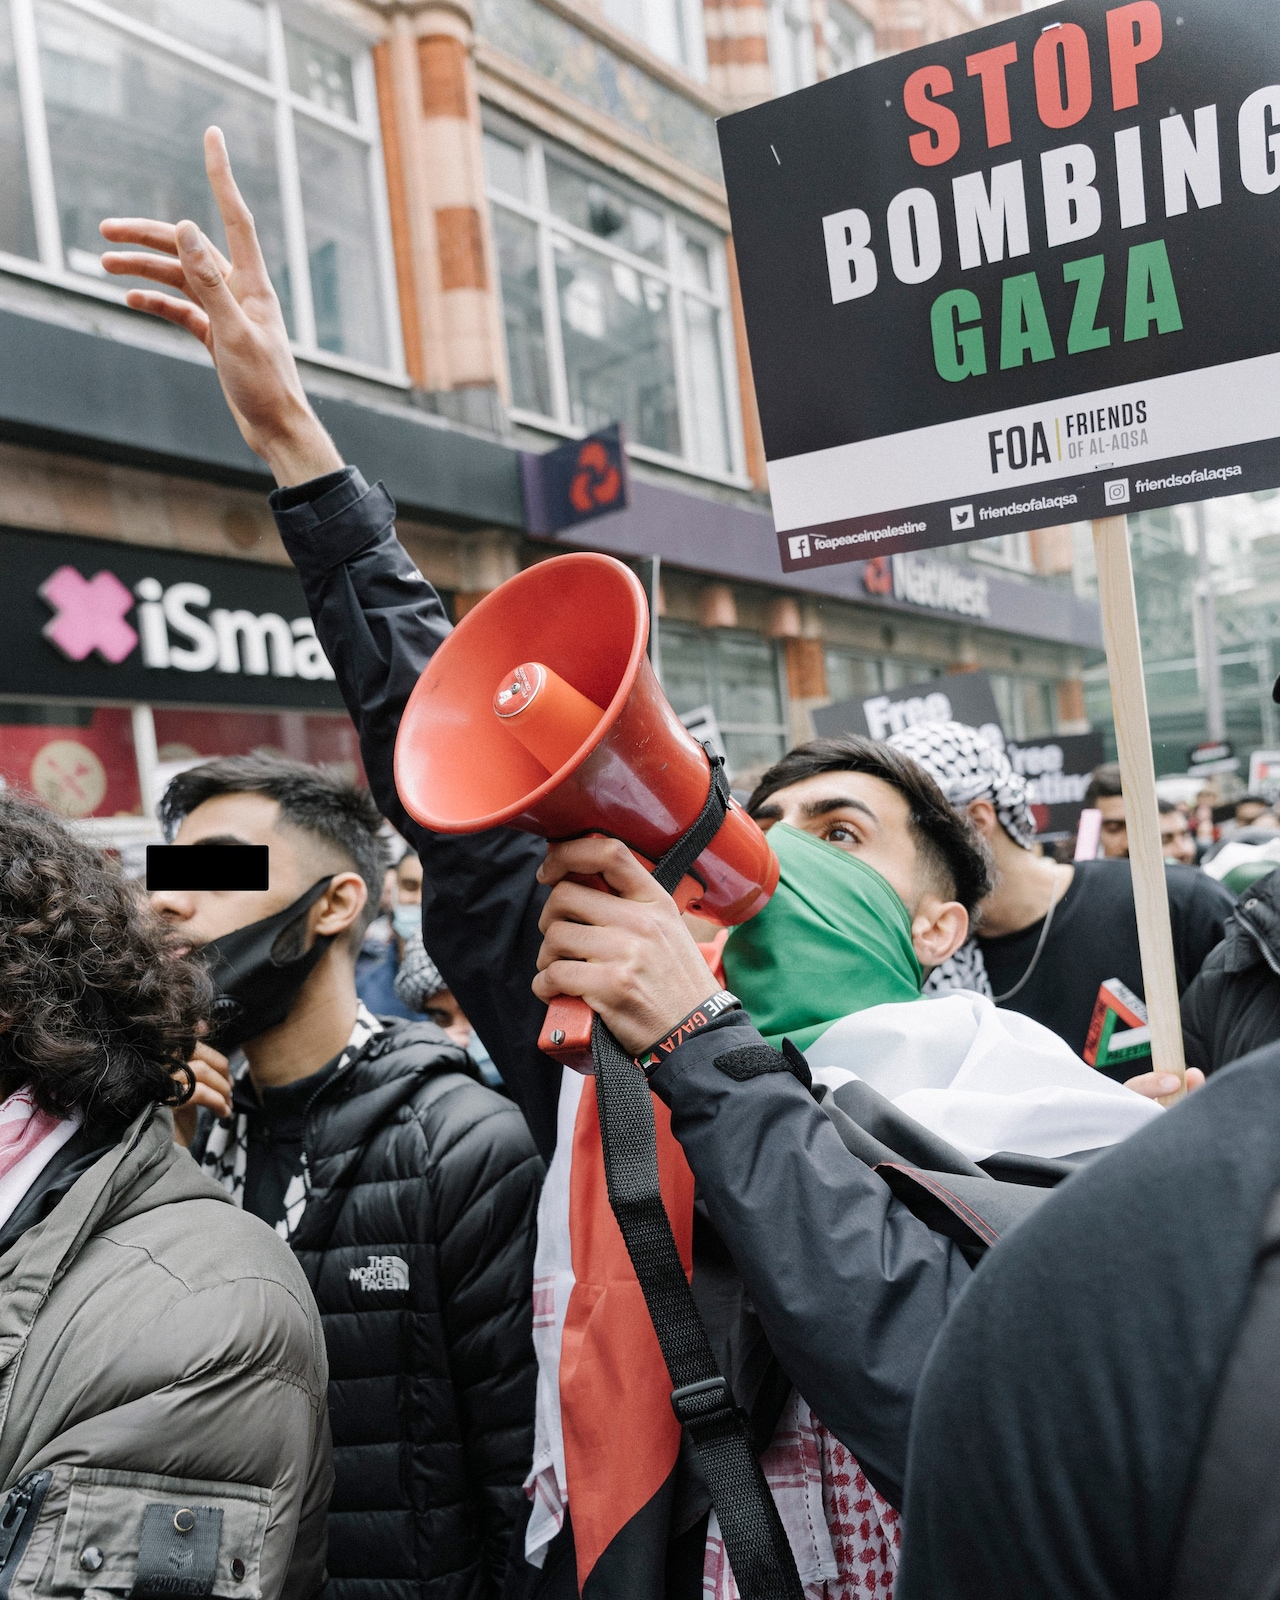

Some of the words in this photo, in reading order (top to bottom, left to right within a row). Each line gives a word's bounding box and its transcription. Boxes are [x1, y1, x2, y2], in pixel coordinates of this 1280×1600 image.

[903, 1, 1163, 167] STOP
[821, 85, 1280, 304] BOMBING
[930, 239, 1184, 382] GAZA
[1066, 400, 1147, 438] FRIENDS
[988, 421, 1052, 474] FOA
[1068, 440, 1085, 459] OF
[1090, 428, 1149, 456] AL-AQSA
[1135, 464, 1243, 493] friendsofalaqsa
[979, 494, 1078, 521] friendsofalaqsa
[814, 521, 927, 550] foapeaceinpalestine
[892, 553, 990, 619] NatWest
[136, 577, 338, 681] iSma
[863, 692, 952, 741] Free
[1007, 743, 1064, 775] ree
[704, 990, 738, 1017] AVE
[659, 1011, 708, 1053] GAZA
[349, 1267, 393, 1281] NORTH
[367, 1255, 393, 1268] THE
[361, 1278, 393, 1292] FACE
